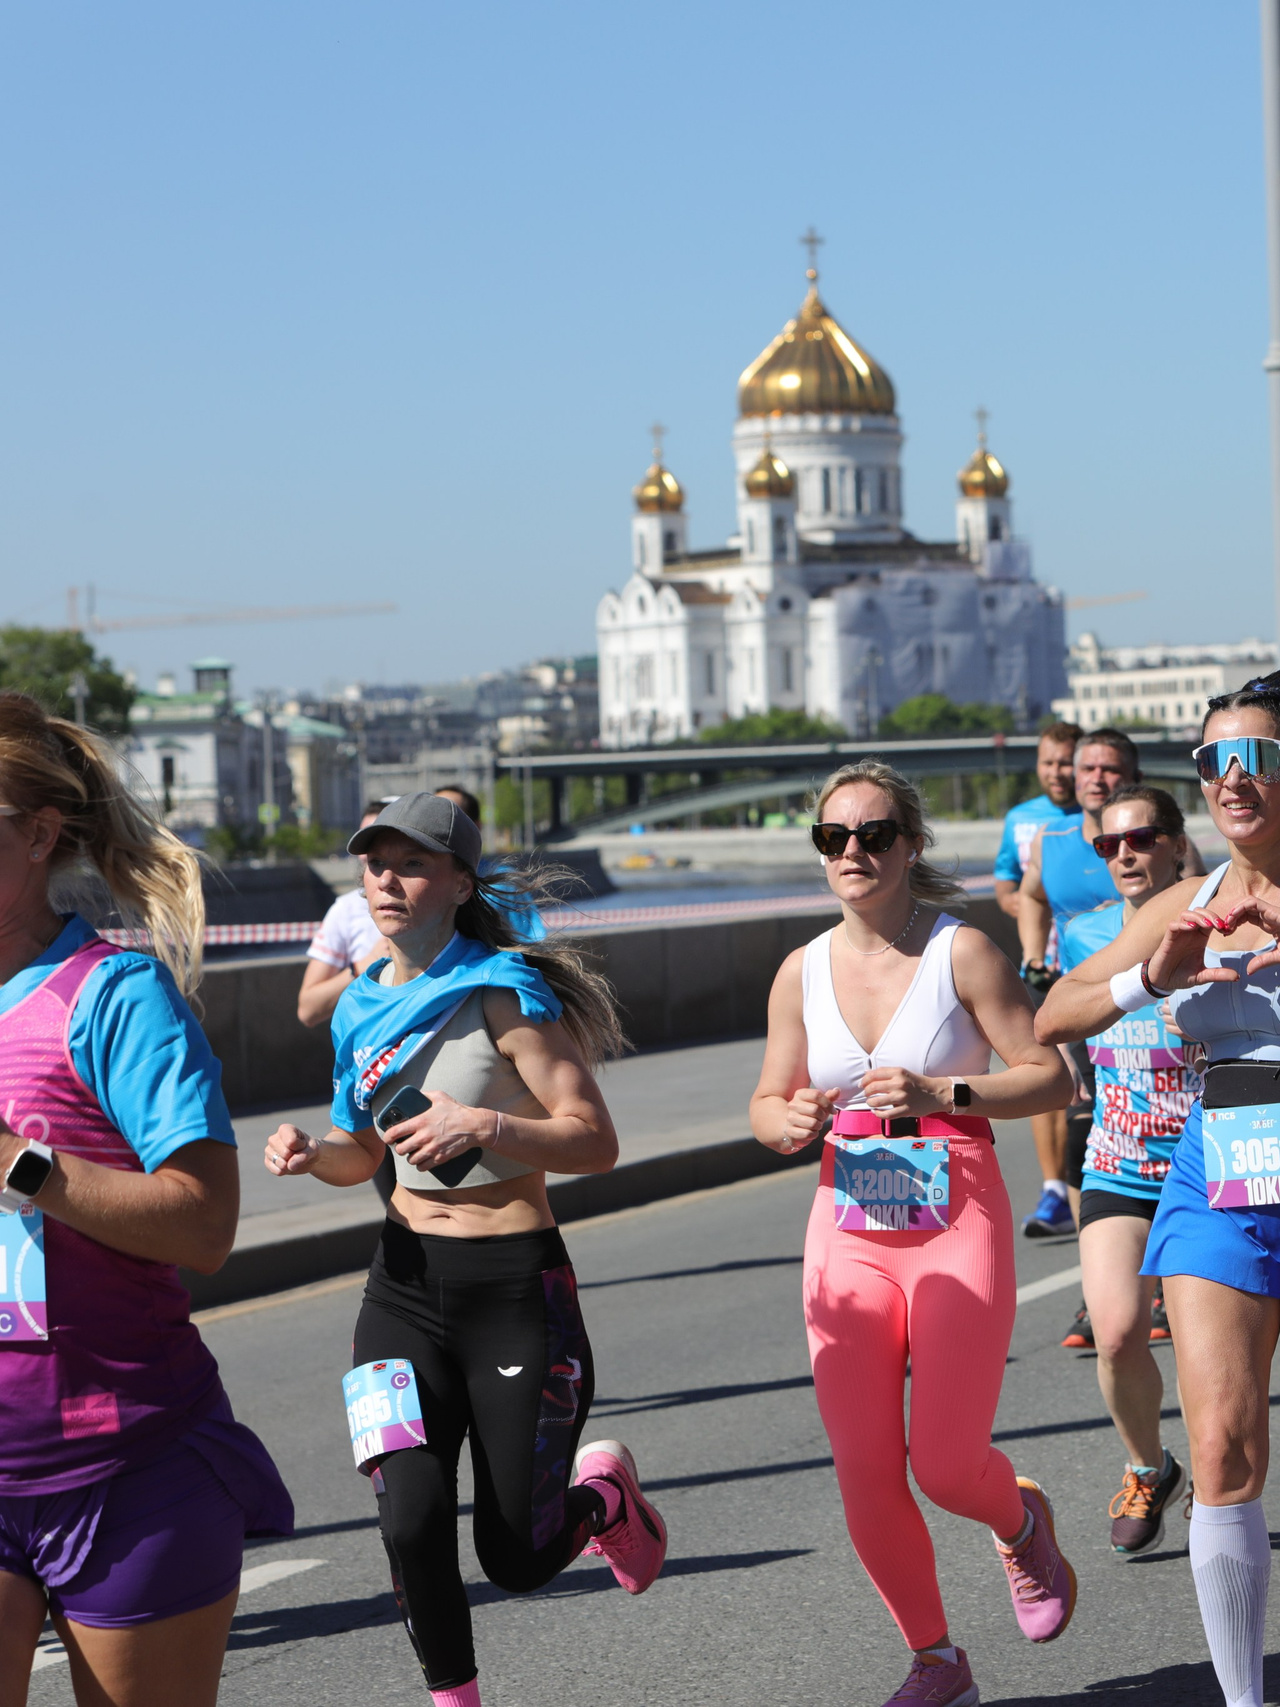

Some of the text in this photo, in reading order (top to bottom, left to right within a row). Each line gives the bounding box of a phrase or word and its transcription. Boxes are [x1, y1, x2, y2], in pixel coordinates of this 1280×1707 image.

[1218, 1112, 1236, 1121] ПСБ
[849, 1143, 863, 1151] ПСБ
[852, 1169, 924, 1200] 32004
[934, 1189, 943, 1199] D
[864, 1205, 909, 1230] 10КМ
[394, 1374, 407, 1387] C
